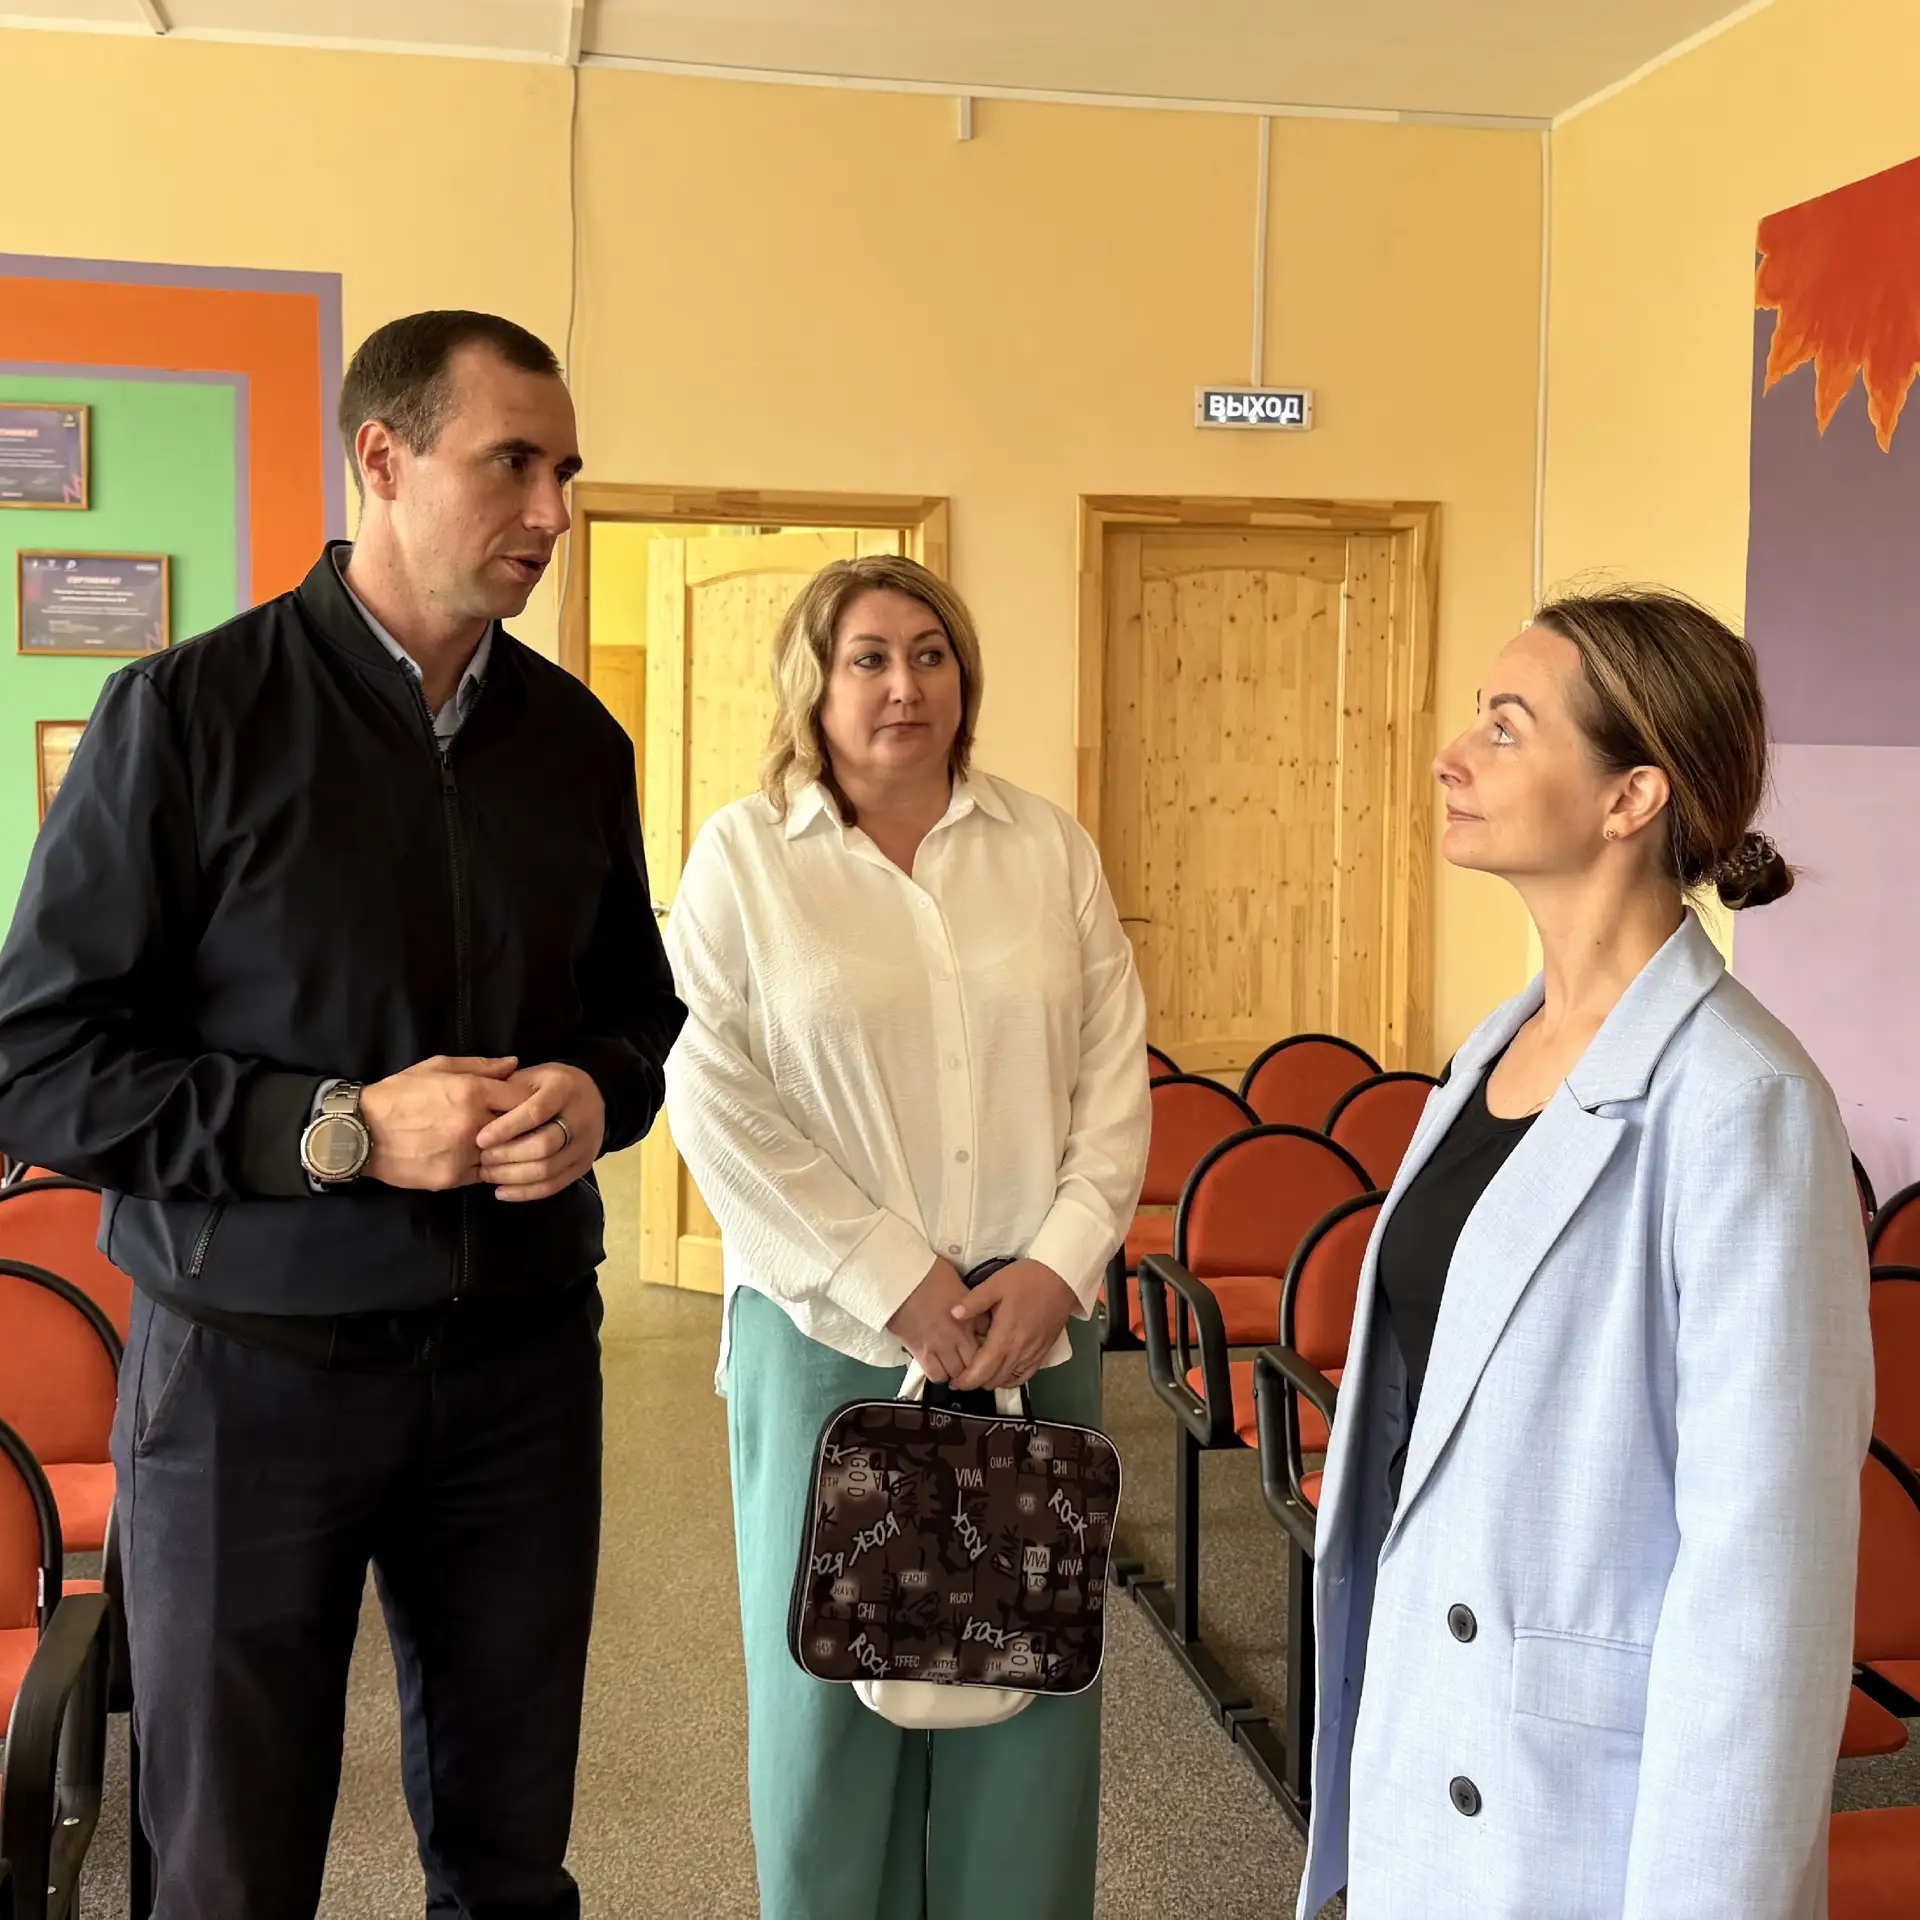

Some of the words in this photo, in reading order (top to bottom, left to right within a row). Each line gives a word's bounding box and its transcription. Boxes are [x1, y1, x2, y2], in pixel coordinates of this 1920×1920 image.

[1209, 395, 1300, 421] ВЫХОД
[955, 1468, 984, 1488] VIVA
[1048, 1488, 1088, 1555] ROCK
[1025, 1551, 1048, 1569] VIVA
[1057, 1558, 1083, 1577] VIVA
[848, 1632, 891, 1679] ROCK
